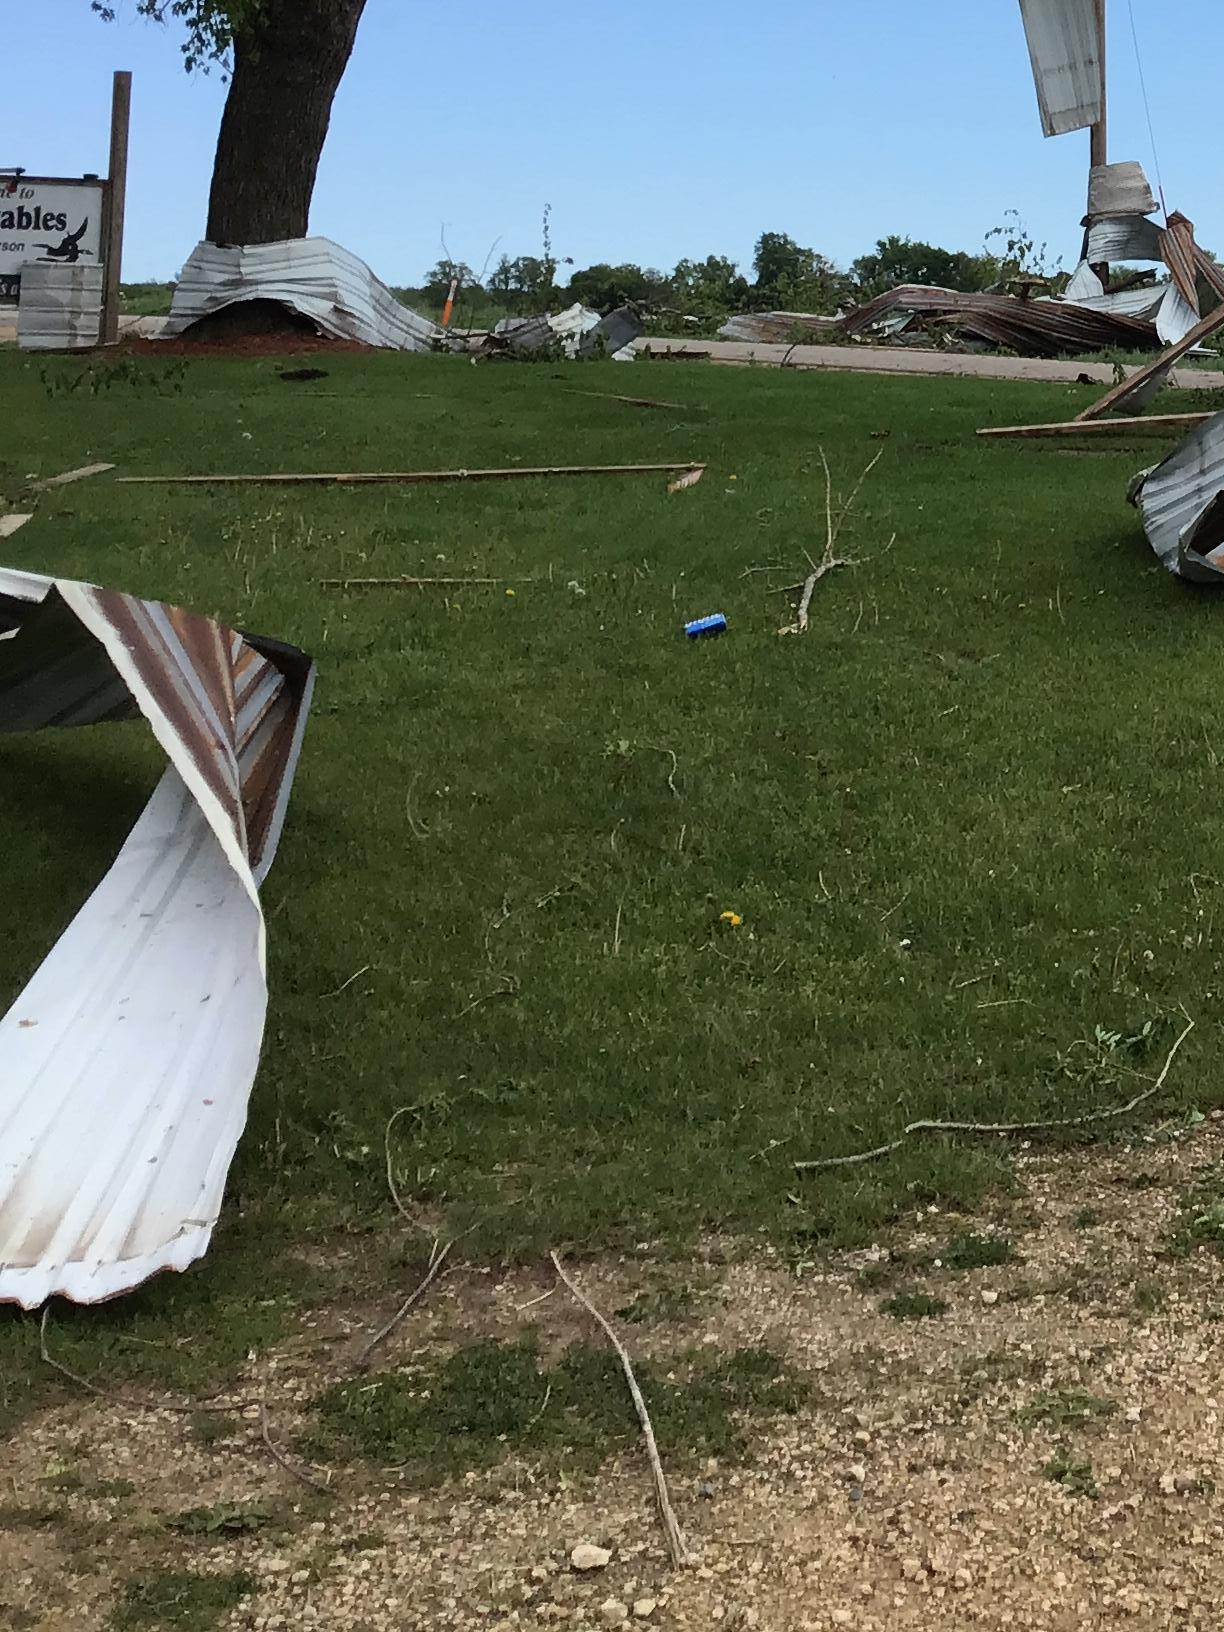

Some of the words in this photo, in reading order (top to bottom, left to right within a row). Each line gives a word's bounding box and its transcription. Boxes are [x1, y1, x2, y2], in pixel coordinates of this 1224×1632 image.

[19, 187, 34, 199] to
[0, 205, 67, 231] ables
[0, 242, 25, 252] son
